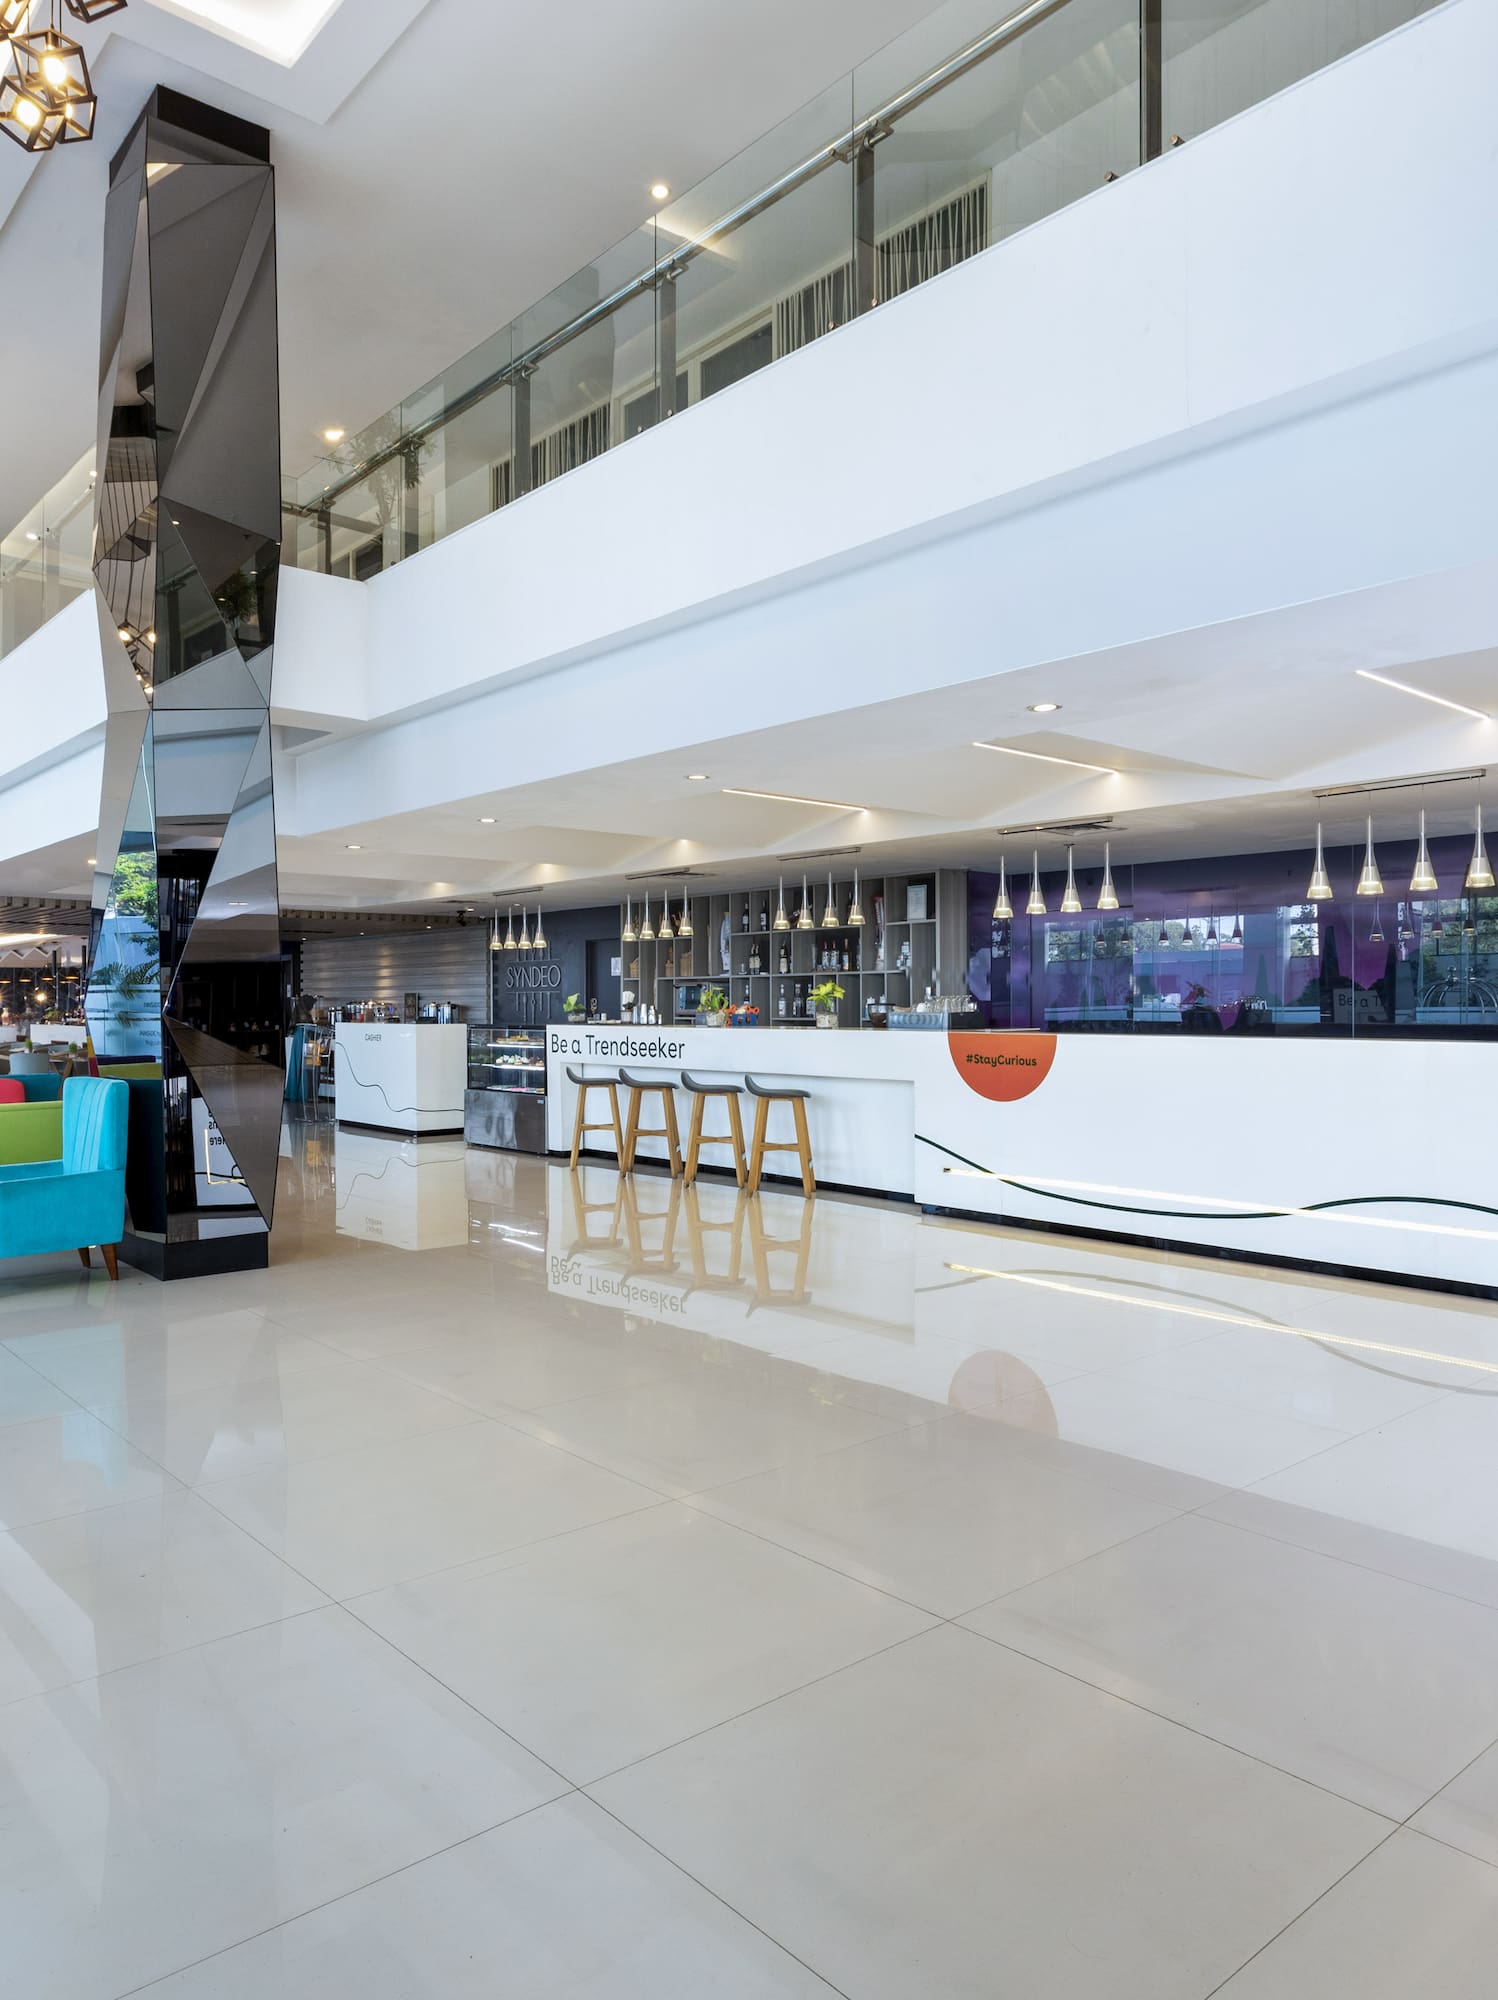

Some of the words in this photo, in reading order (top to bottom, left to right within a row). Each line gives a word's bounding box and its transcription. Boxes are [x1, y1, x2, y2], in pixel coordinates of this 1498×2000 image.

[506, 964, 561, 988] SYNDEO
[551, 1034, 568, 1053] Be
[571, 1039, 582, 1054] a
[585, 1034, 686, 1059] Trendseeker
[966, 1053, 1038, 1068] #StayCurious
